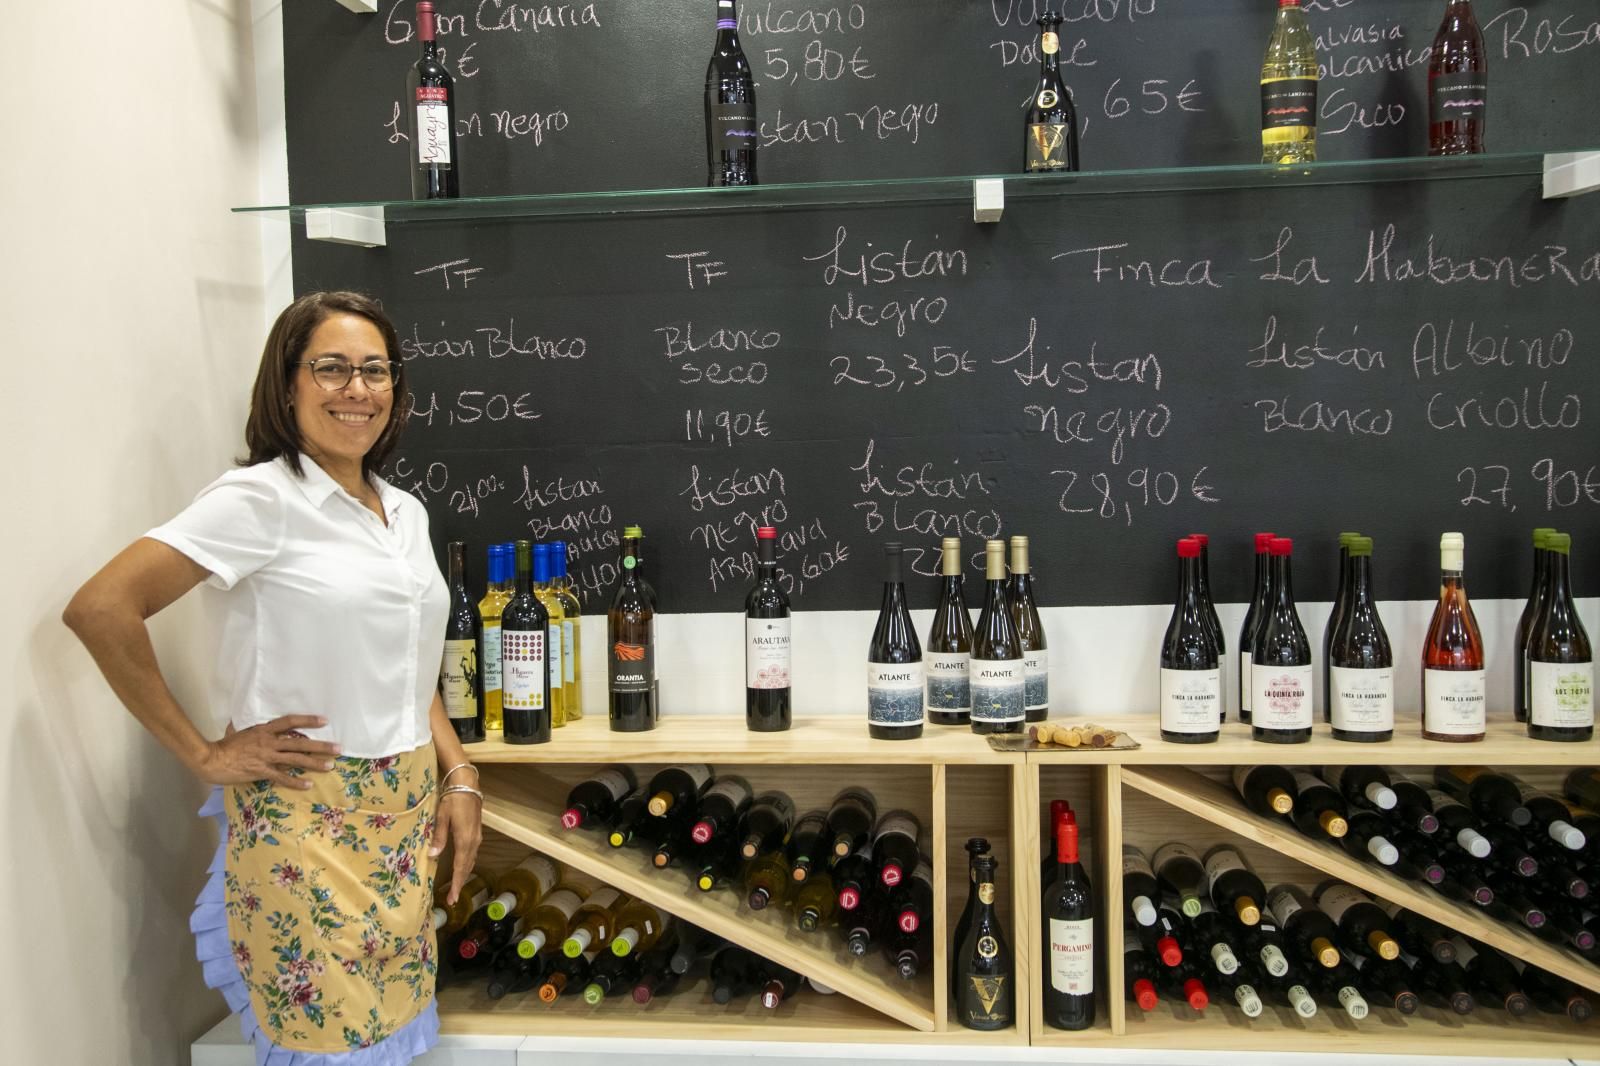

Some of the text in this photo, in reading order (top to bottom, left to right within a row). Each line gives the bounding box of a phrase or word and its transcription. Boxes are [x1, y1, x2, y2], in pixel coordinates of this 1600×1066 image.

[1306, 22, 1404, 52] alvasia
[934, 662, 965, 670] ATLANTE
[878, 673, 911, 681] ATLANTE
[980, 670, 1013, 678] ATLANTE
[1052, 942, 1092, 953] PERGAMINO
